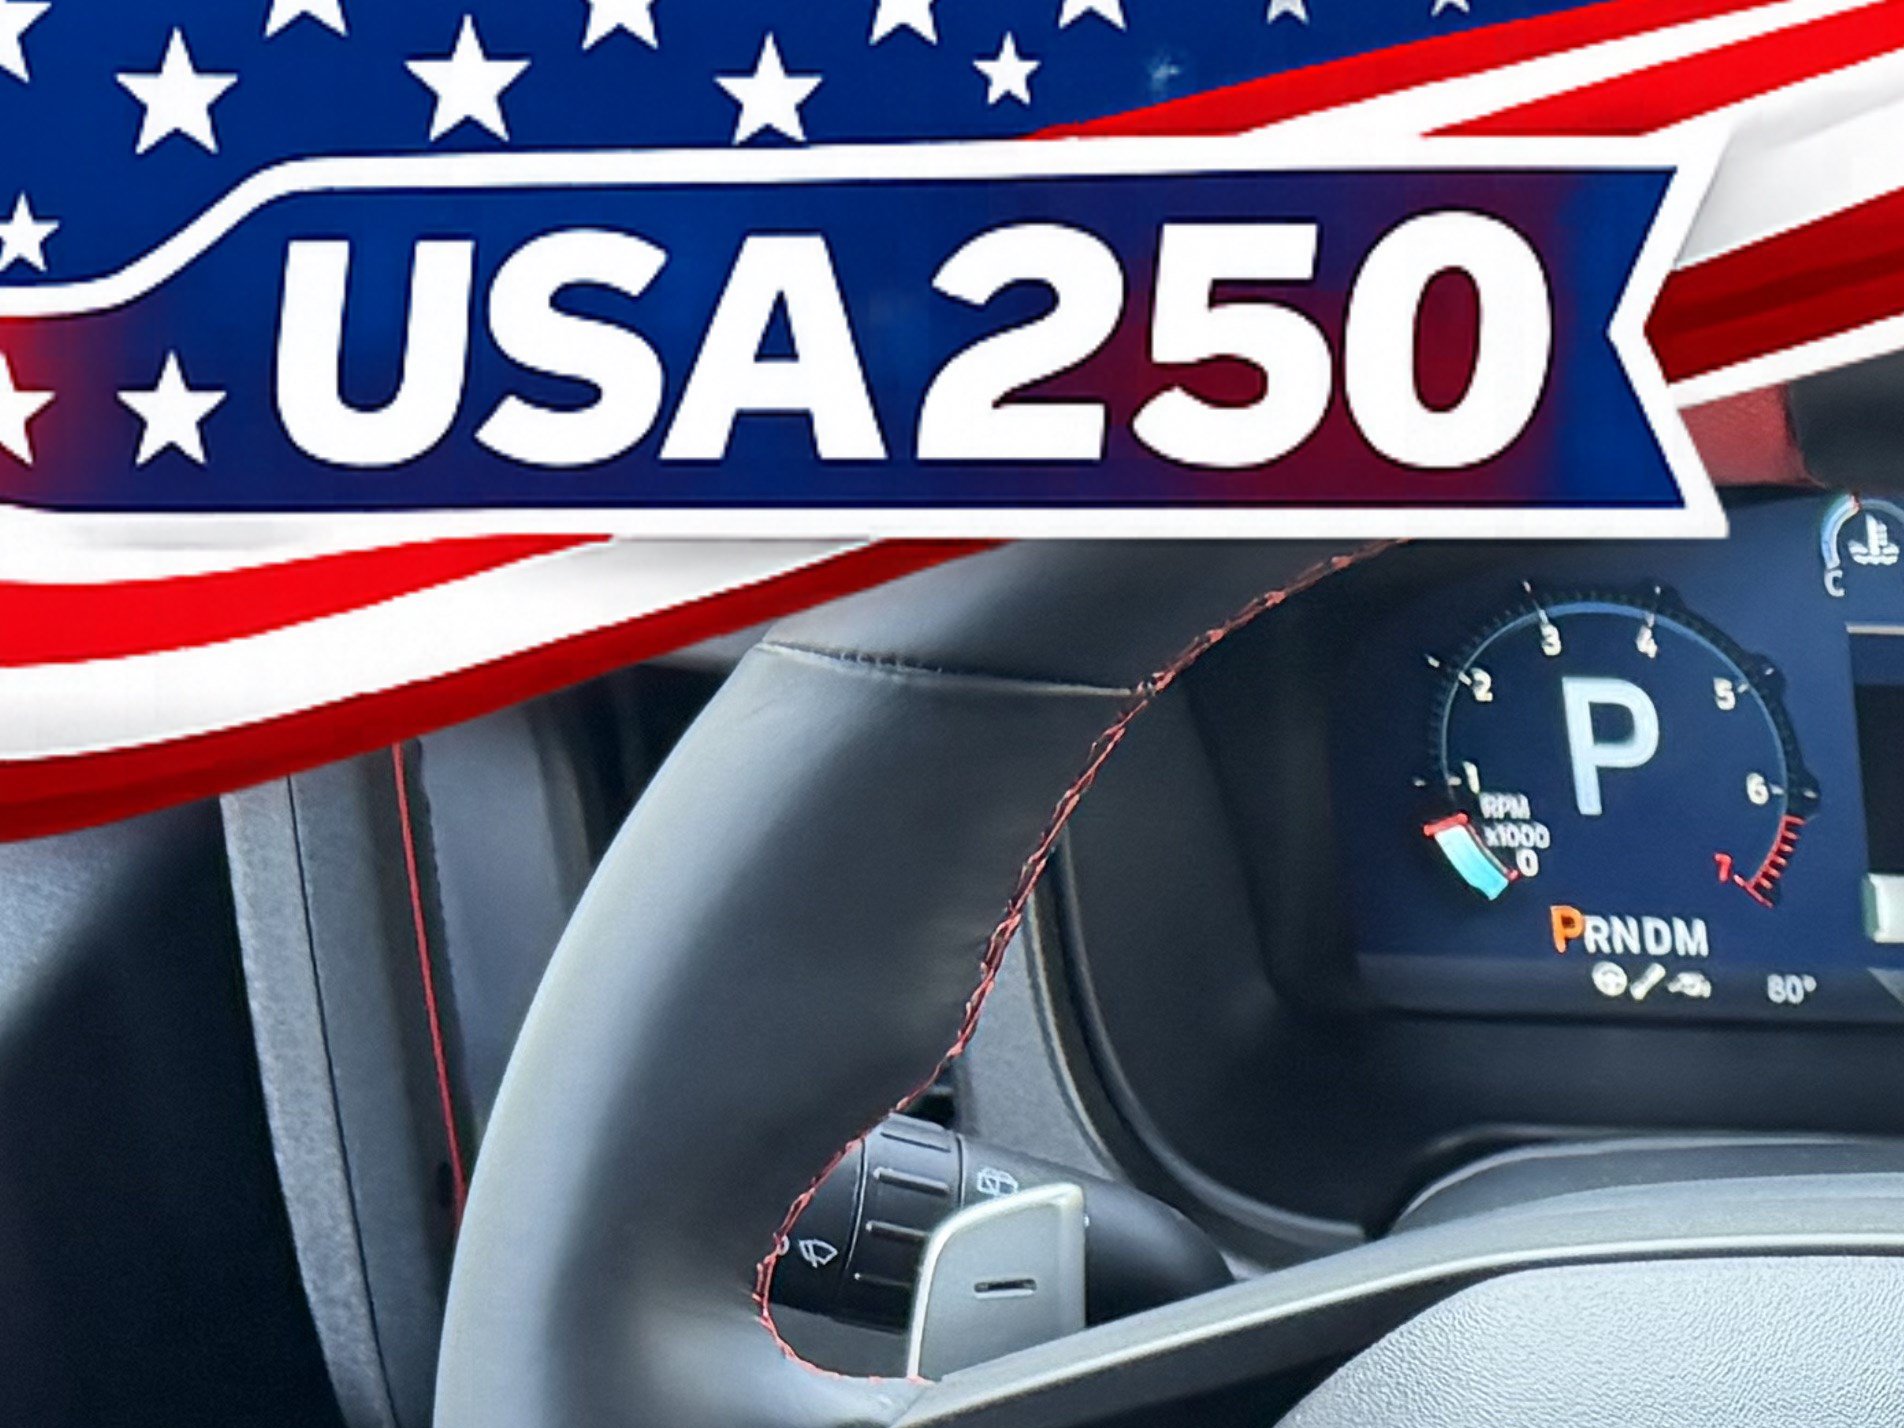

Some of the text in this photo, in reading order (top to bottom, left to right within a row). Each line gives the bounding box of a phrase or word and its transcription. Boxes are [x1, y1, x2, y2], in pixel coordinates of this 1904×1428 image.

[1541, 626, 1562, 657] 3
[1636, 627, 1658, 659] 4
[1471, 668, 1494, 702] 2
[1713, 678, 1736, 711] 5
[1562, 676, 1660, 816] P
[1746, 772, 1769, 806] 6
[1479, 793, 1531, 820] RPM
[1515, 849, 1539, 878] 0
